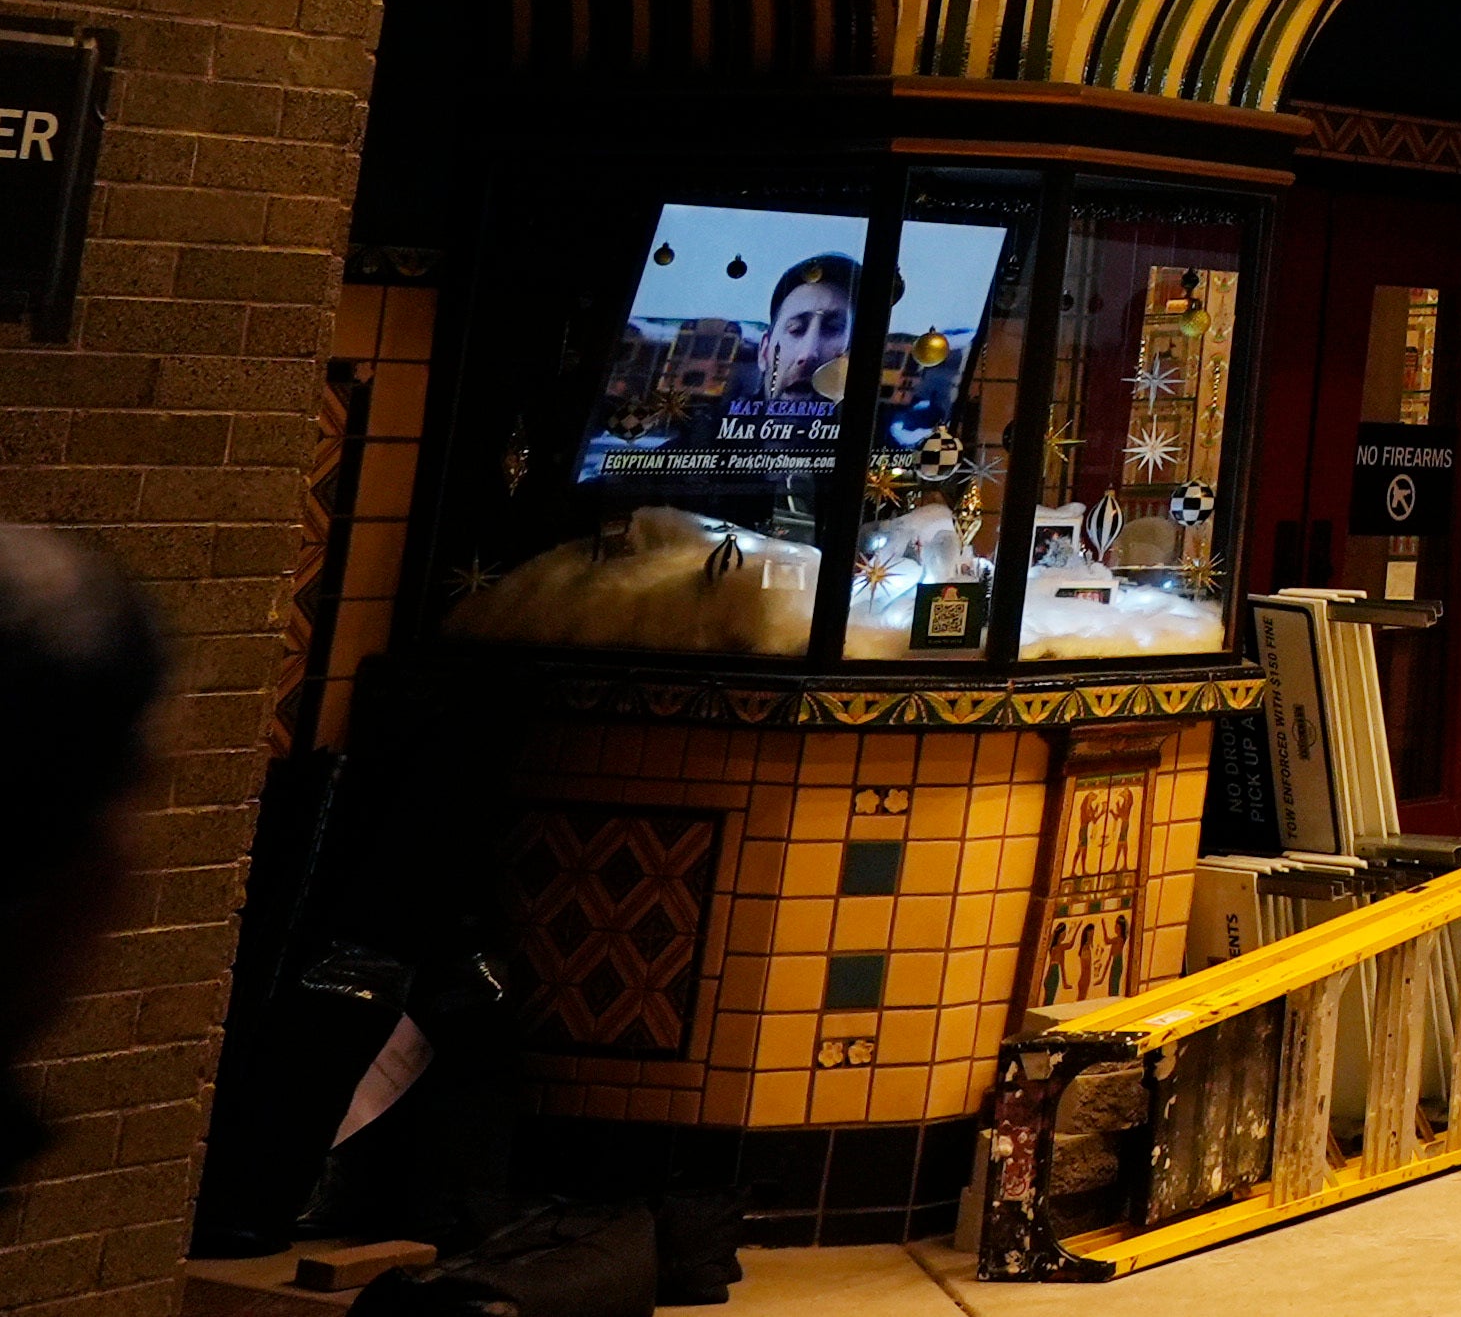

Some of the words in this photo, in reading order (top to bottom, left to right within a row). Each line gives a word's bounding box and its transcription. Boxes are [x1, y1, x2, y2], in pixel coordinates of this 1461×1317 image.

[0, 107, 60, 162] ER
[729, 400, 761, 417] MAT
[765, 400, 838, 417] KEARNEY
[759, 417, 793, 441] 6TH
[807, 418, 841, 441] 8TH
[604, 453, 666, 470] EGYPTIAN
[666, 453, 719, 469] THEATRE
[726, 453, 837, 470] ParkCityShows.com
[1355, 444, 1379, 467] NO
[1381, 445, 1454, 469] FIREARMS
[1262, 615, 1277, 649] FINE
[1267, 652, 1282, 687] $150
[1271, 689, 1287, 729] WITH
[1219, 716, 1240, 777] DROP
[1242, 736, 1260, 769] UP
[1275, 732, 1298, 804] ENFORCED
[1226, 782, 1244, 815] NO
[1246, 773, 1266, 824] PICK
[1286, 805, 1299, 840] TOW
